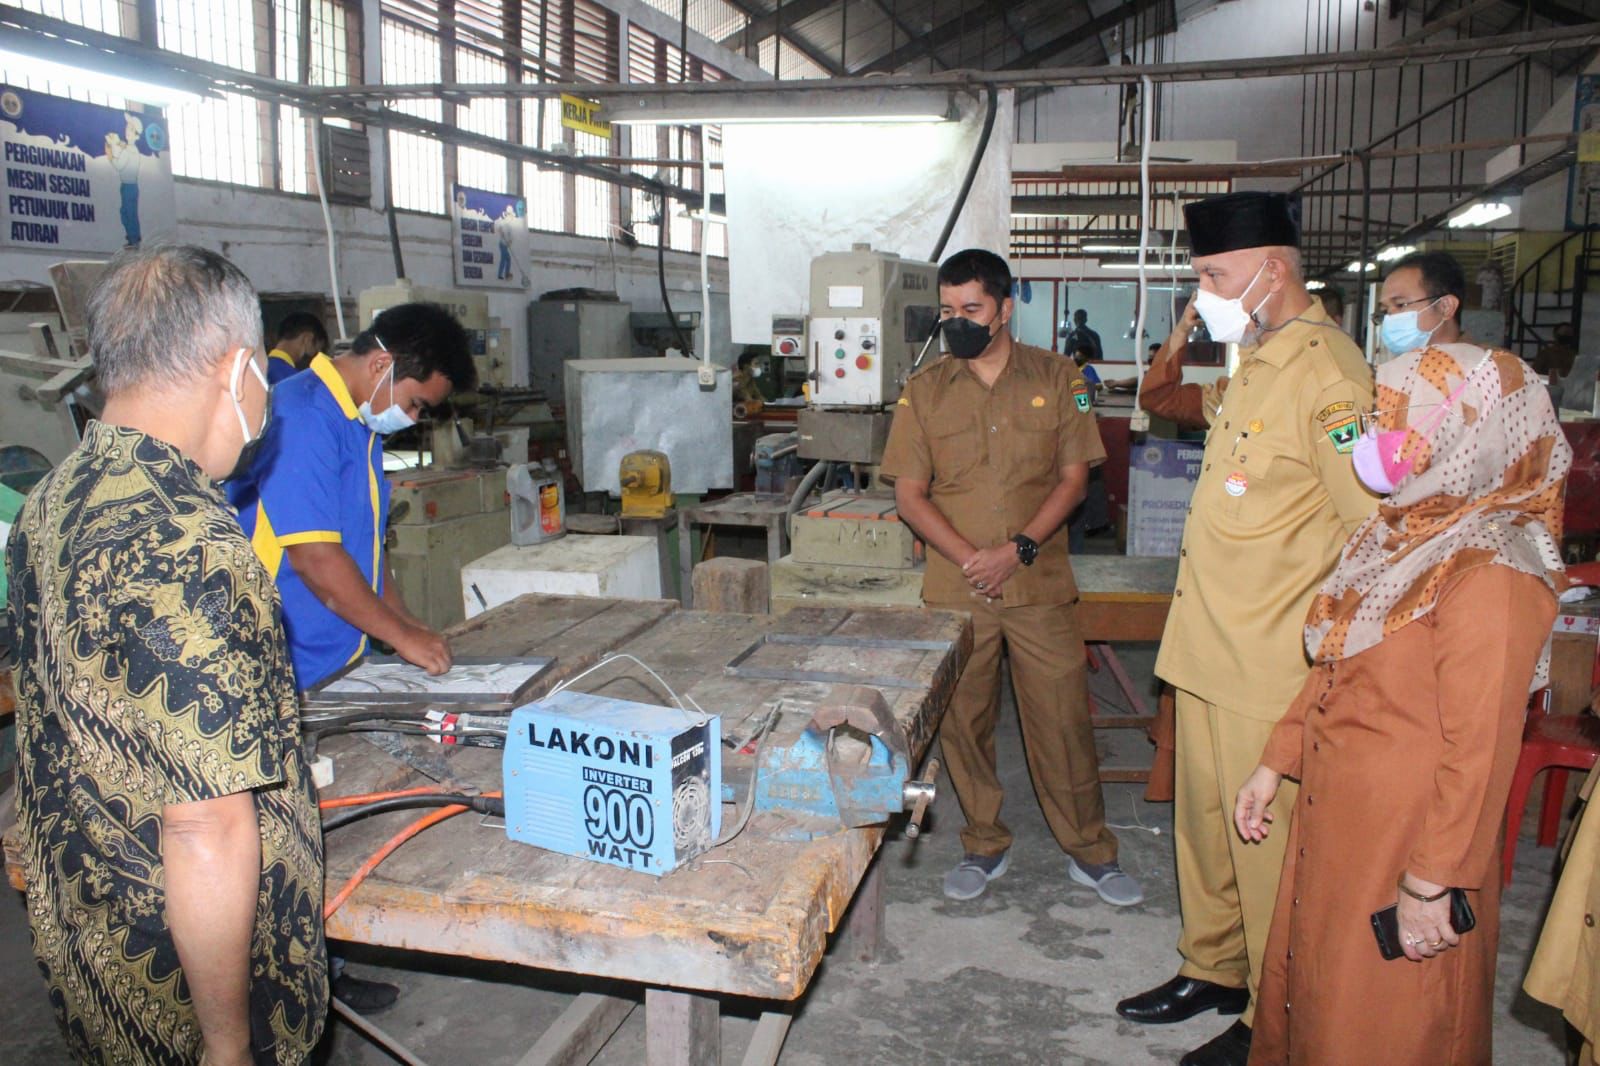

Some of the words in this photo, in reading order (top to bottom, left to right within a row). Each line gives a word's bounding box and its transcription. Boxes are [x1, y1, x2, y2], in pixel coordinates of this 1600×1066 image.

[563, 101, 588, 124] KERJA
[5, 141, 86, 172] PERGUNAKAN
[7, 168, 47, 192] MESIN
[49, 175, 91, 198] SESUAI
[9, 194, 70, 220] PETUNJUK
[71, 202, 95, 222] DAN
[11, 221, 59, 244] ATURAN
[528, 722, 653, 769] LAKONI
[584, 768, 649, 793] INVERTER
[584, 784, 655, 850] 900
[587, 839, 654, 868] WATT
